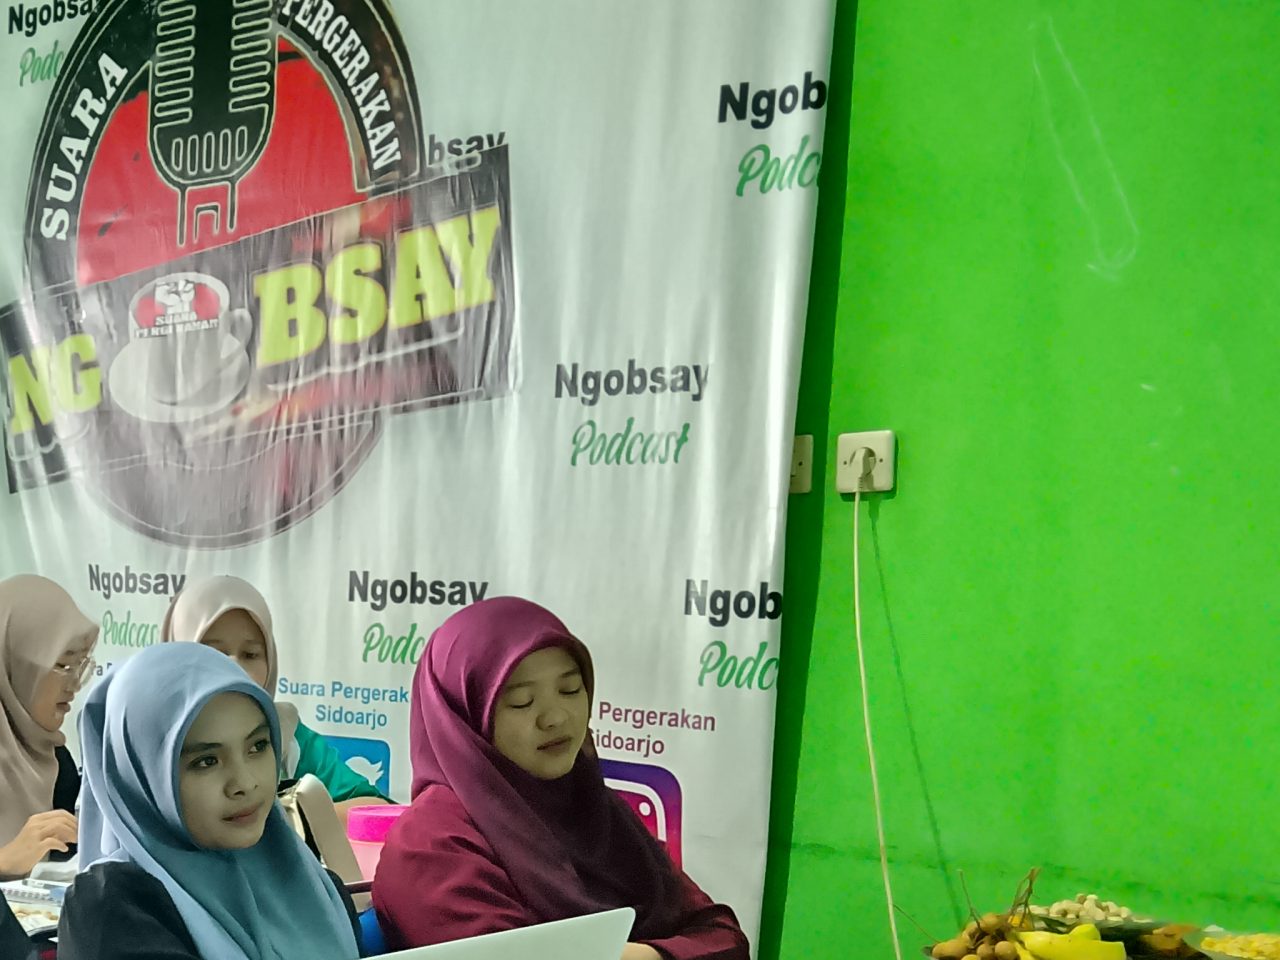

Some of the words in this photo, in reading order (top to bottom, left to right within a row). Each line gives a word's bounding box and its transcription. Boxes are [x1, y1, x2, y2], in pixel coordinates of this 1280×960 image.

[8, 0, 95, 37] Ngobsa
[19, 39, 65, 87] Podc
[40, 52, 128, 241] SUARA
[428, 131, 506, 166] bsay
[253, 206, 500, 368] BSAY
[554, 358, 710, 406] Ngobsay
[570, 416, 691, 467] Podcast
[102, 609, 160, 648] Podcas
[362, 622, 426, 665] Podc
[278, 677, 326, 697] Suara
[331, 681, 410, 704] Pergerak
[315, 704, 388, 730] Sidoarjo
[599, 701, 717, 732] Pergerakan
